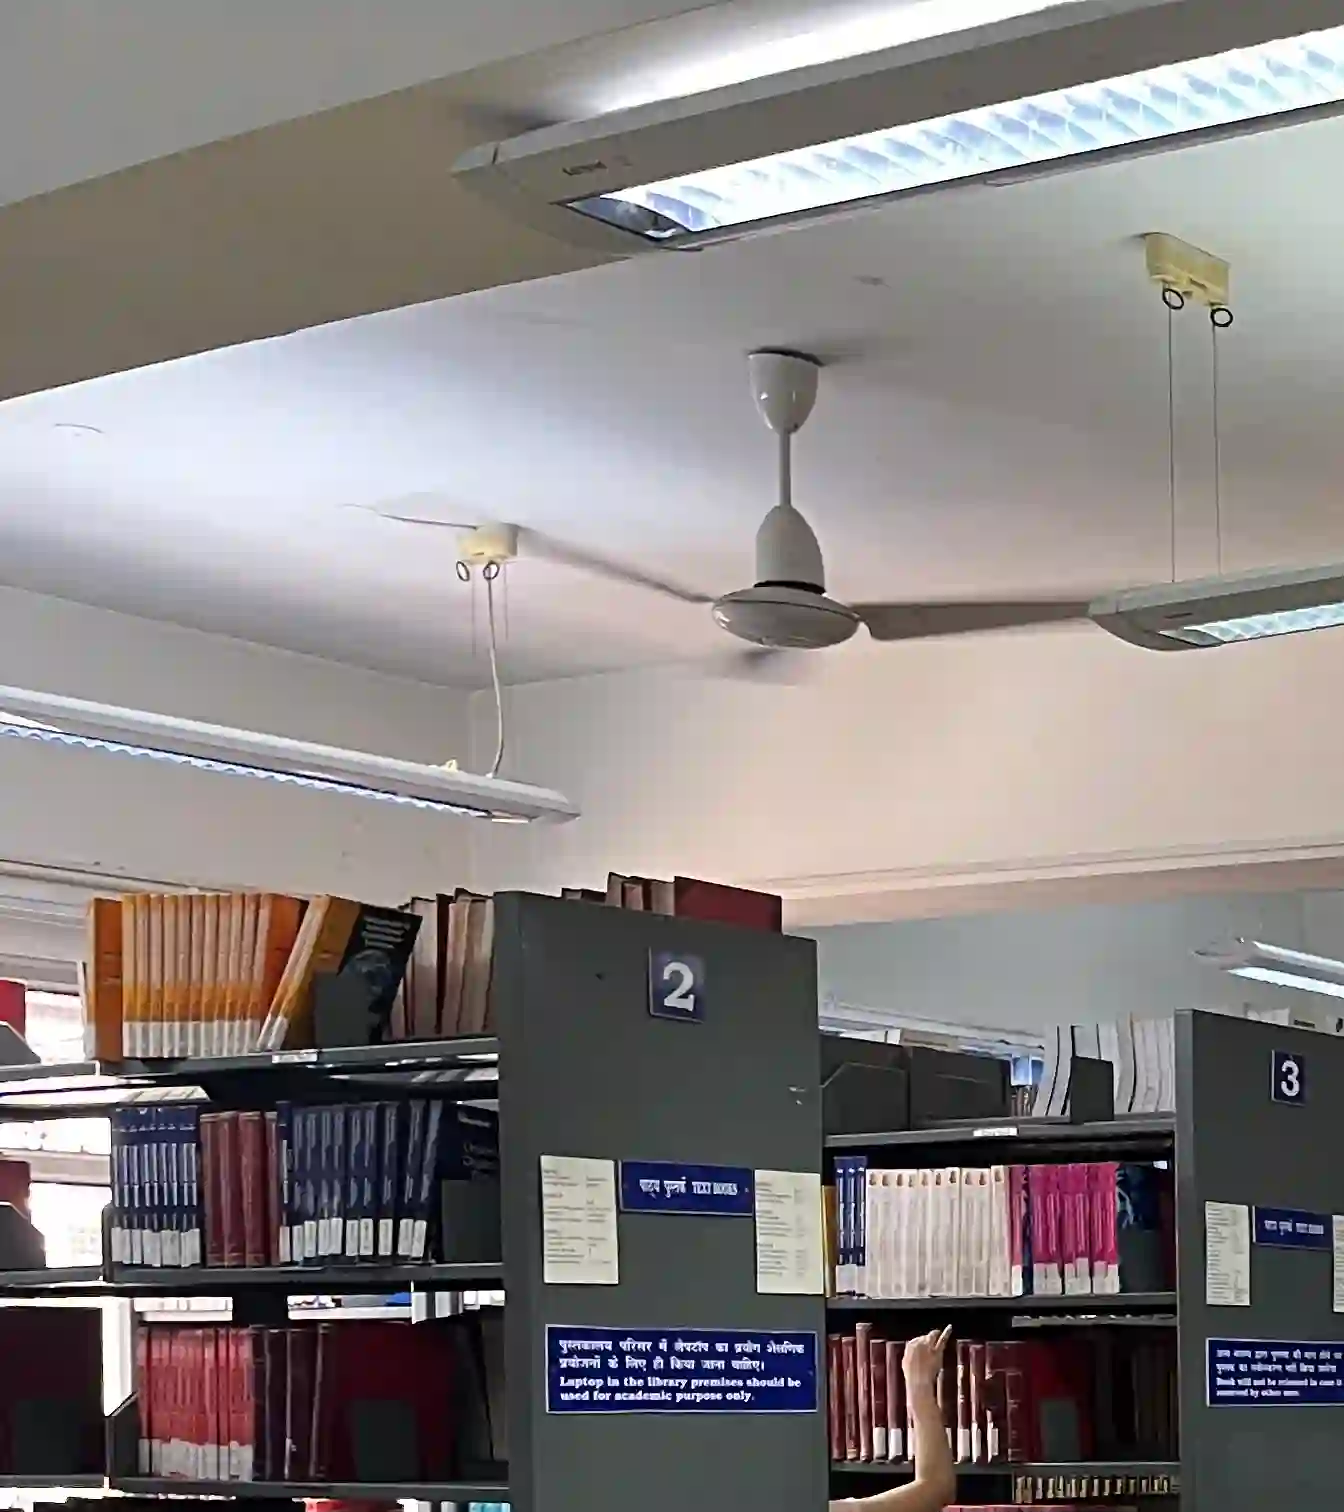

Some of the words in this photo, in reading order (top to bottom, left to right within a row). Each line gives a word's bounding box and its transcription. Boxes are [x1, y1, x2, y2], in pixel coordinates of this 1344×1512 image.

[663, 962, 695, 1011] 2
[1281, 1060, 1300, 1096] 3
[692, 1181, 711, 1194] TEXT
[713, 1182, 738, 1196] BOOKS
[619, 1337, 652, 1352] परिसर
[658, 1338, 668, 1352] में
[715, 1342, 728, 1352] का
[734, 1340, 760, 1353] प्रयोग
[608, 1355, 619, 1369] के
[625, 1355, 647, 1372] लिए
[653, 1355, 664, 1370] ही
[670, 1356, 694, 1370] किया
[560, 1376, 604, 1389] Laptop
[607, 1376, 620, 1387] in
[624, 1377, 644, 1387] the
[647, 1376, 688, 1390] library
[691, 1377, 744, 1389] premises
[746, 1377, 785, 1387] should
[788, 1377, 801, 1387] be
[560, 1390, 590, 1401] used
[593, 1390, 612, 1401] for
[614, 1390, 672, 1401] academic
[675, 1392, 723, 1403] purpose
[726, 1390, 755, 1403] only.
